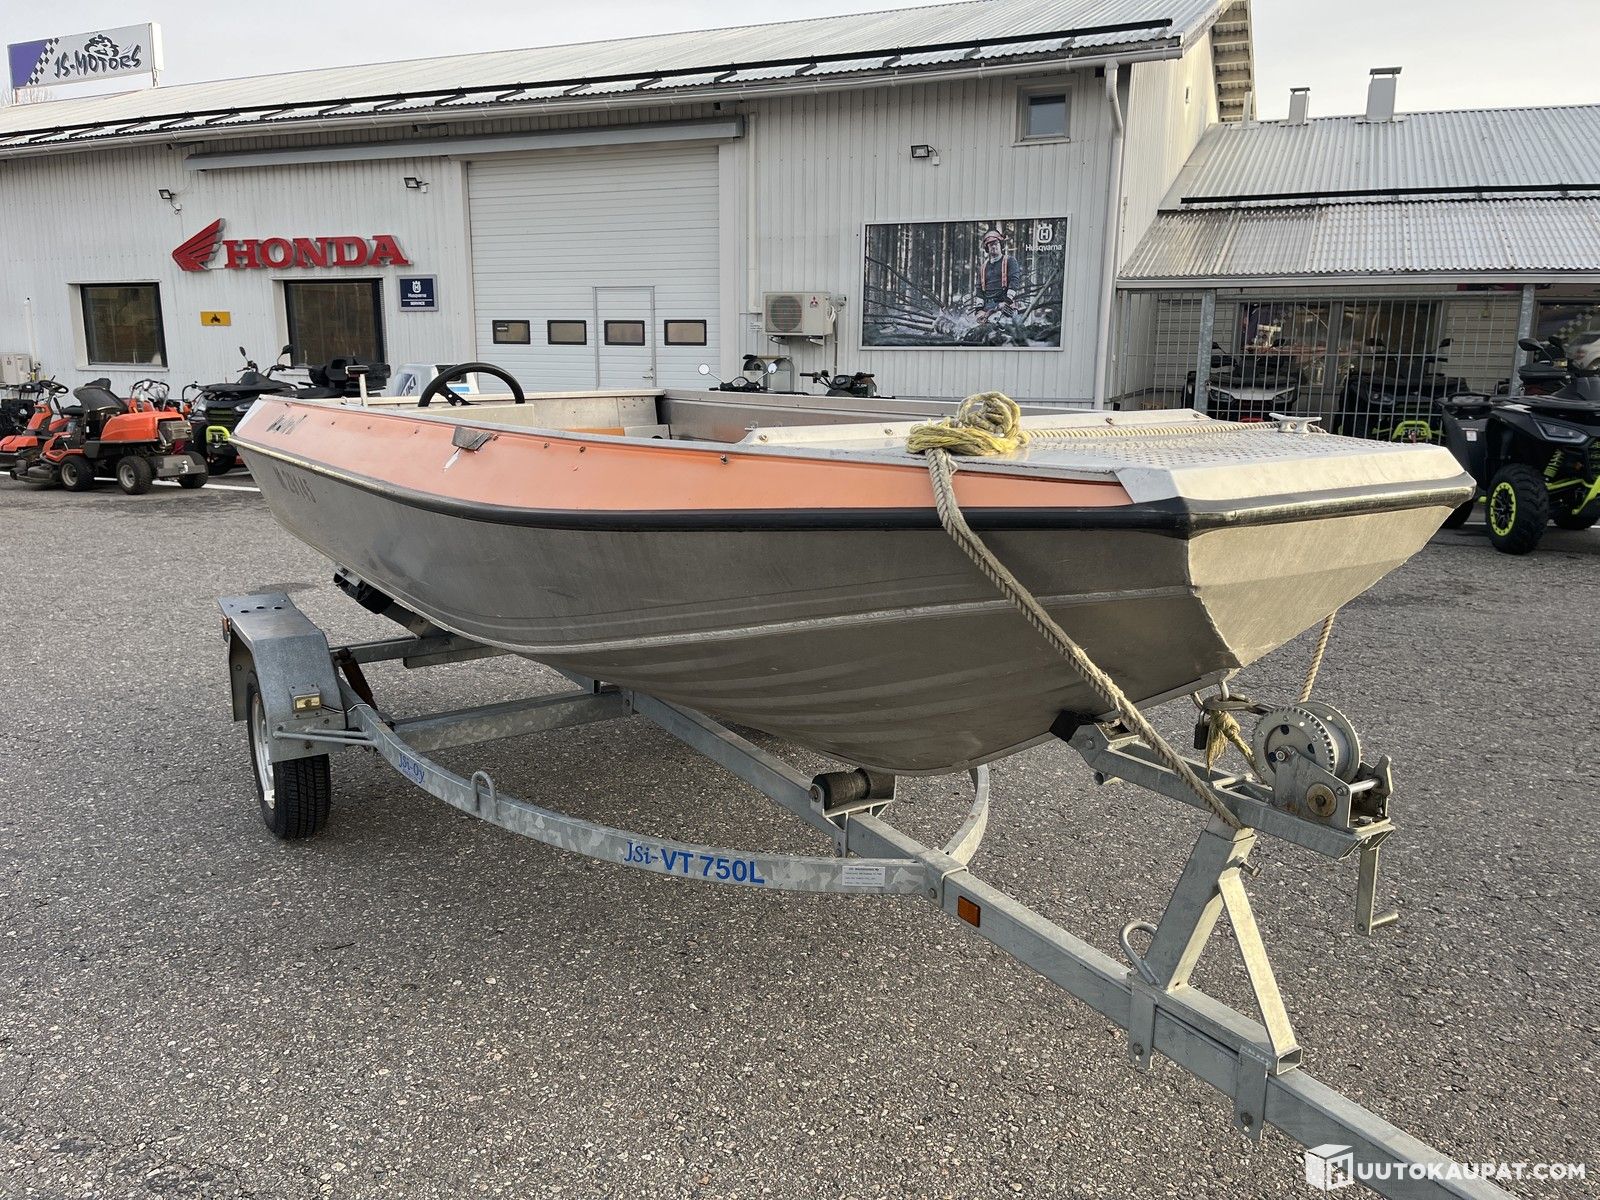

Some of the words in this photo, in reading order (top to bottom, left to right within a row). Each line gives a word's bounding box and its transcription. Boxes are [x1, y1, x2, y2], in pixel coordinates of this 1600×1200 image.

[54, 44, 142, 79] JS-MOTORS
[222, 235, 412, 269] HONDA
[1025, 244, 1062, 252] Husqvarna
[624, 841, 694, 874] JSi-VT
[699, 855, 765, 884] 750L
